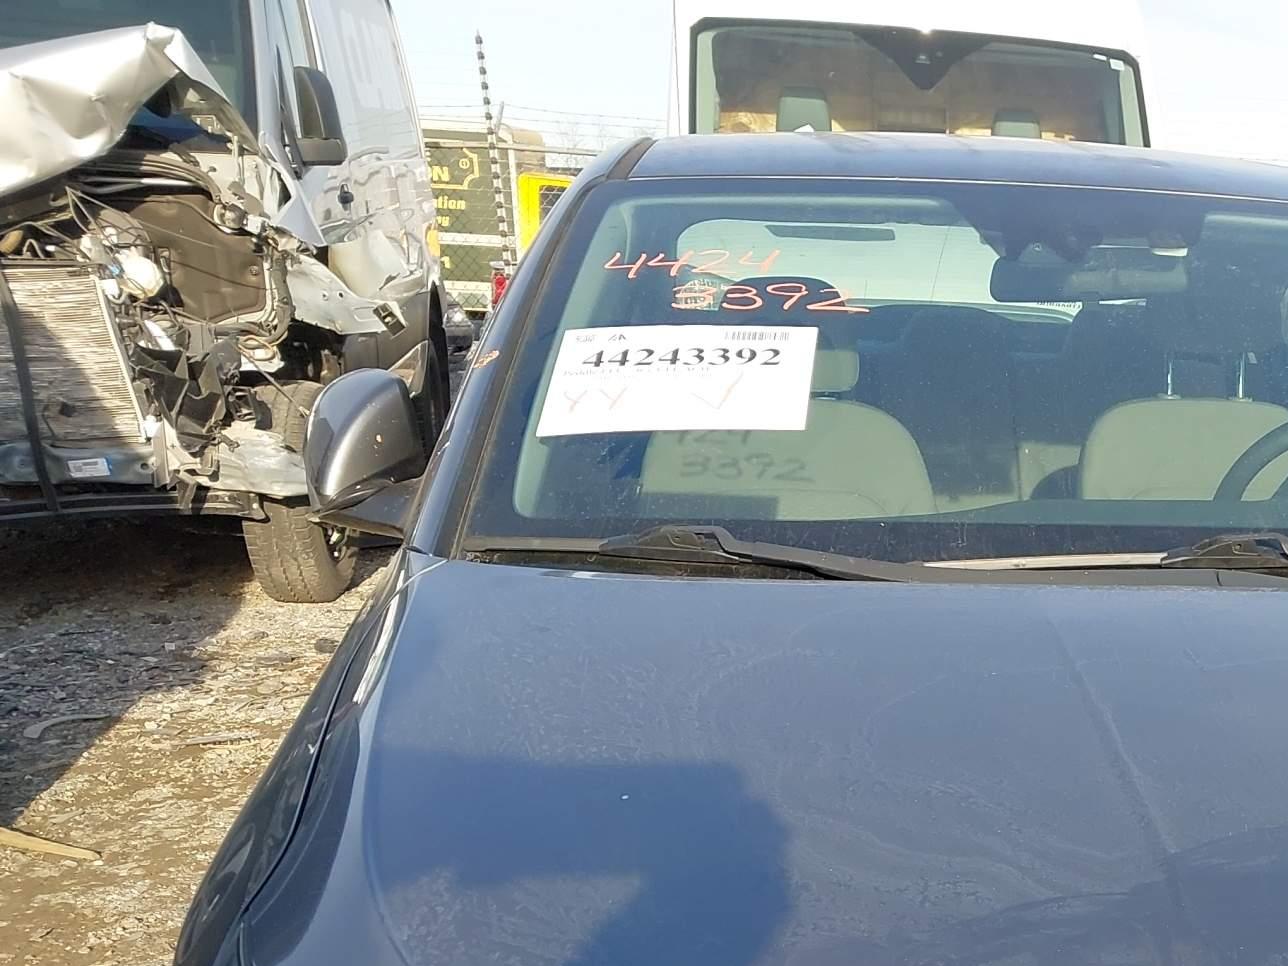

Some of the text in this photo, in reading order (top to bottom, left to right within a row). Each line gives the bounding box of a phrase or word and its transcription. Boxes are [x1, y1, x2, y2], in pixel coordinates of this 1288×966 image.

[604, 249, 780, 279] 4424
[671, 282, 870, 313] 3392
[581, 347, 781, 368] 44243392
